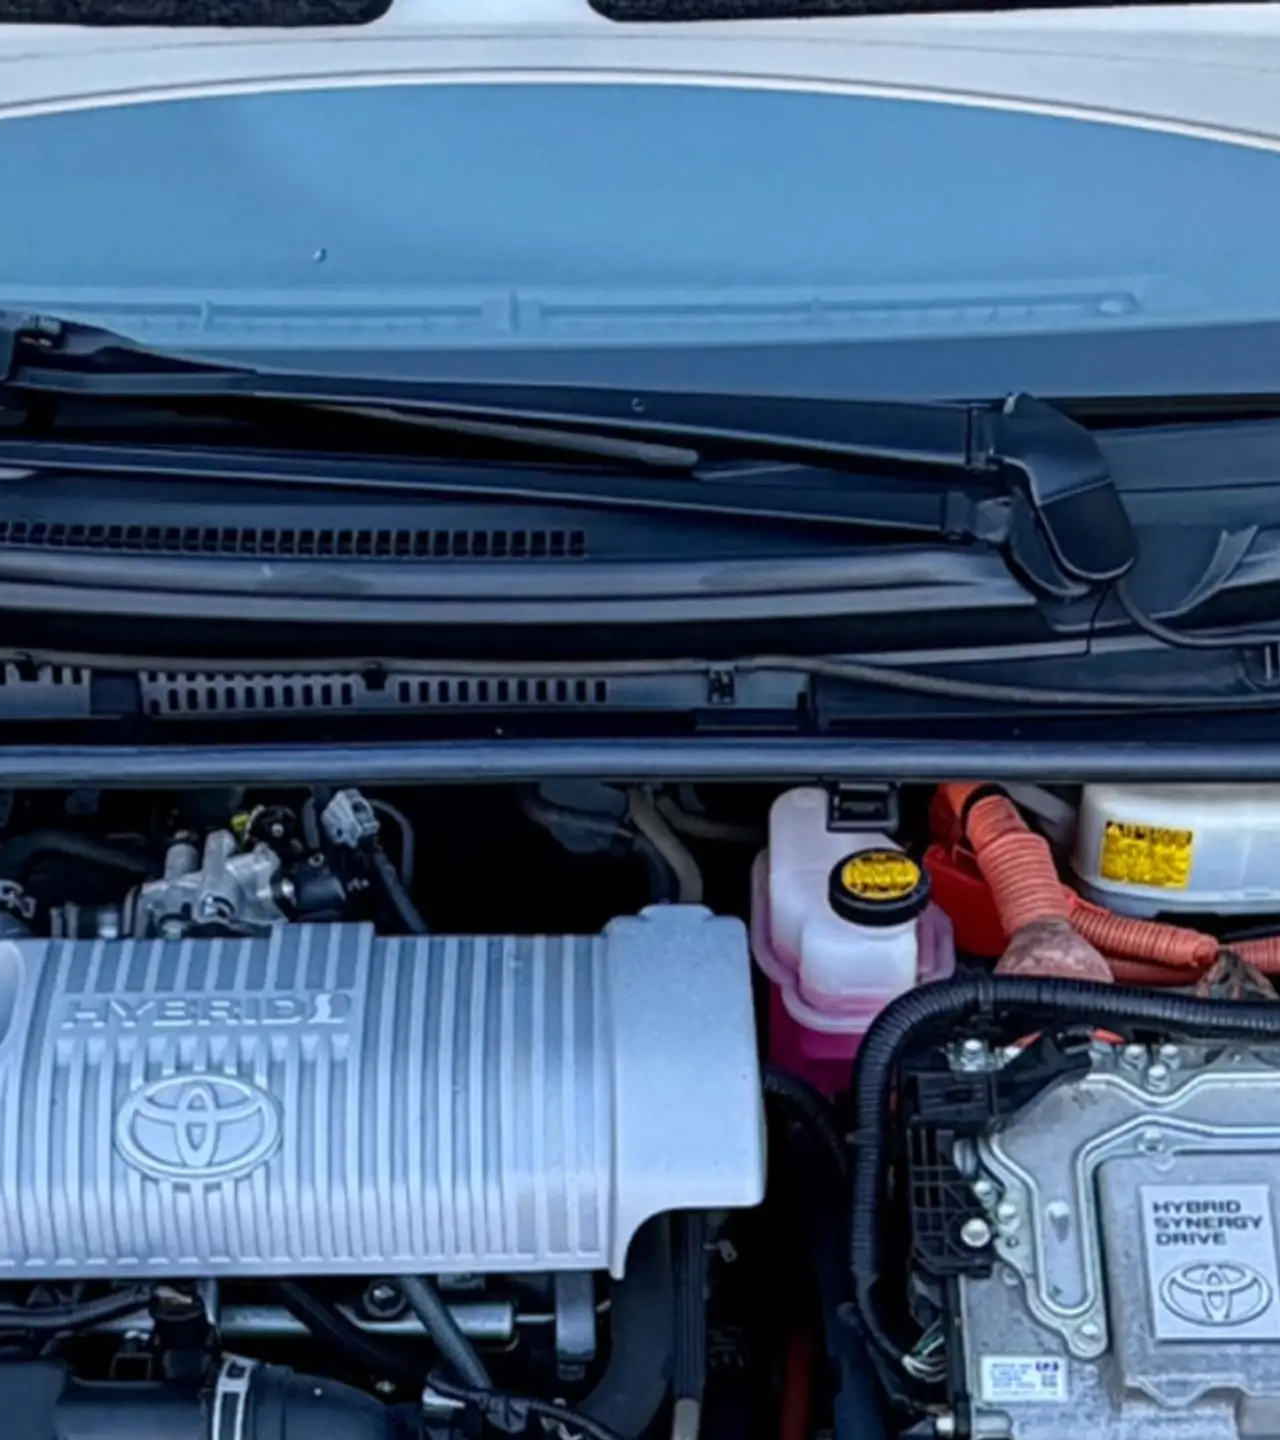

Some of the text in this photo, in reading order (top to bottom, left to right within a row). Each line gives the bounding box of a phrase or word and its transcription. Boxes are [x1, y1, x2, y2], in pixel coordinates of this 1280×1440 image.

[1153, 1200, 1241, 1214] HYBRID
[1154, 1215, 1263, 1230] SYNERGY
[1156, 1233, 1227, 1246] DRIVE
